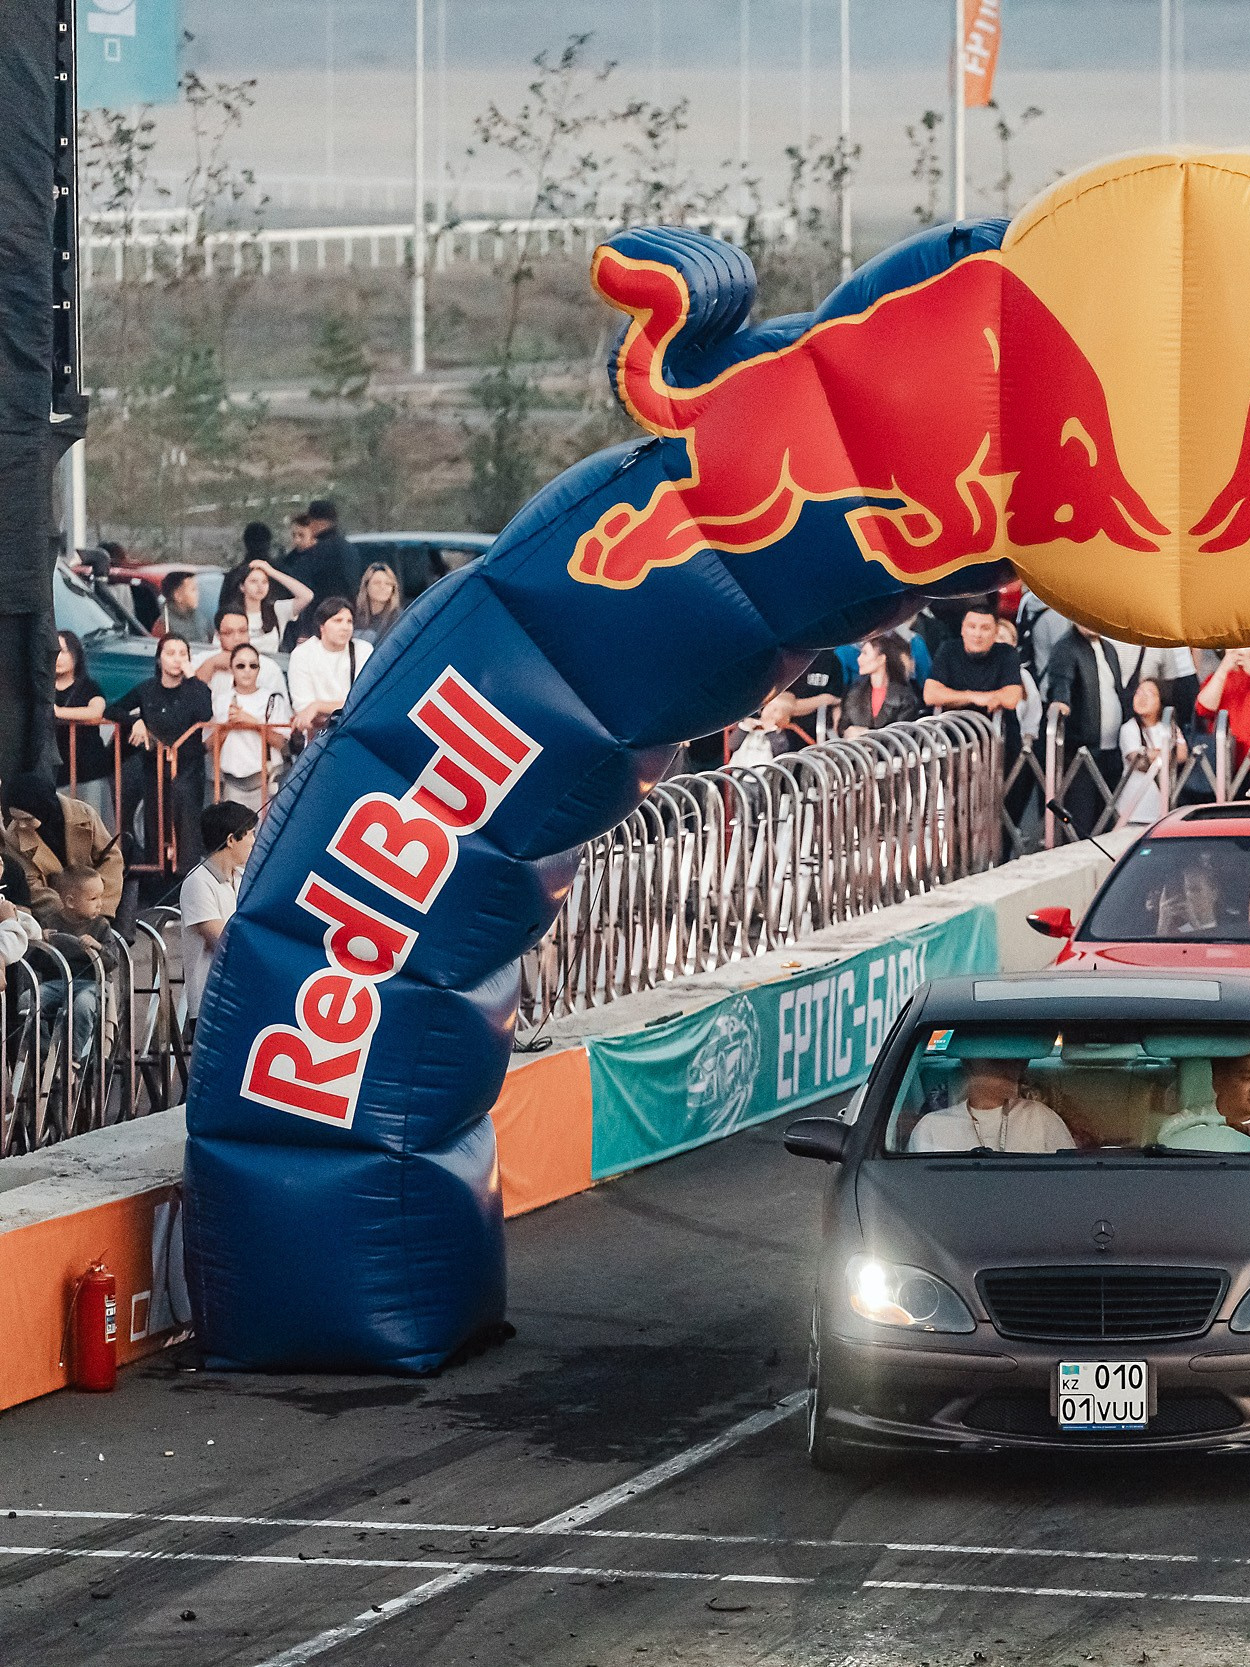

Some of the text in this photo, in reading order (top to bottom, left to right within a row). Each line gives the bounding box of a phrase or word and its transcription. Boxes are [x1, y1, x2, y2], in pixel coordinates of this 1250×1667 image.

[247, 674, 533, 1121] Red Bull
[1062, 1364, 1143, 1390] KZ 010
[1062, 1398, 1144, 1421] 01 VUU
